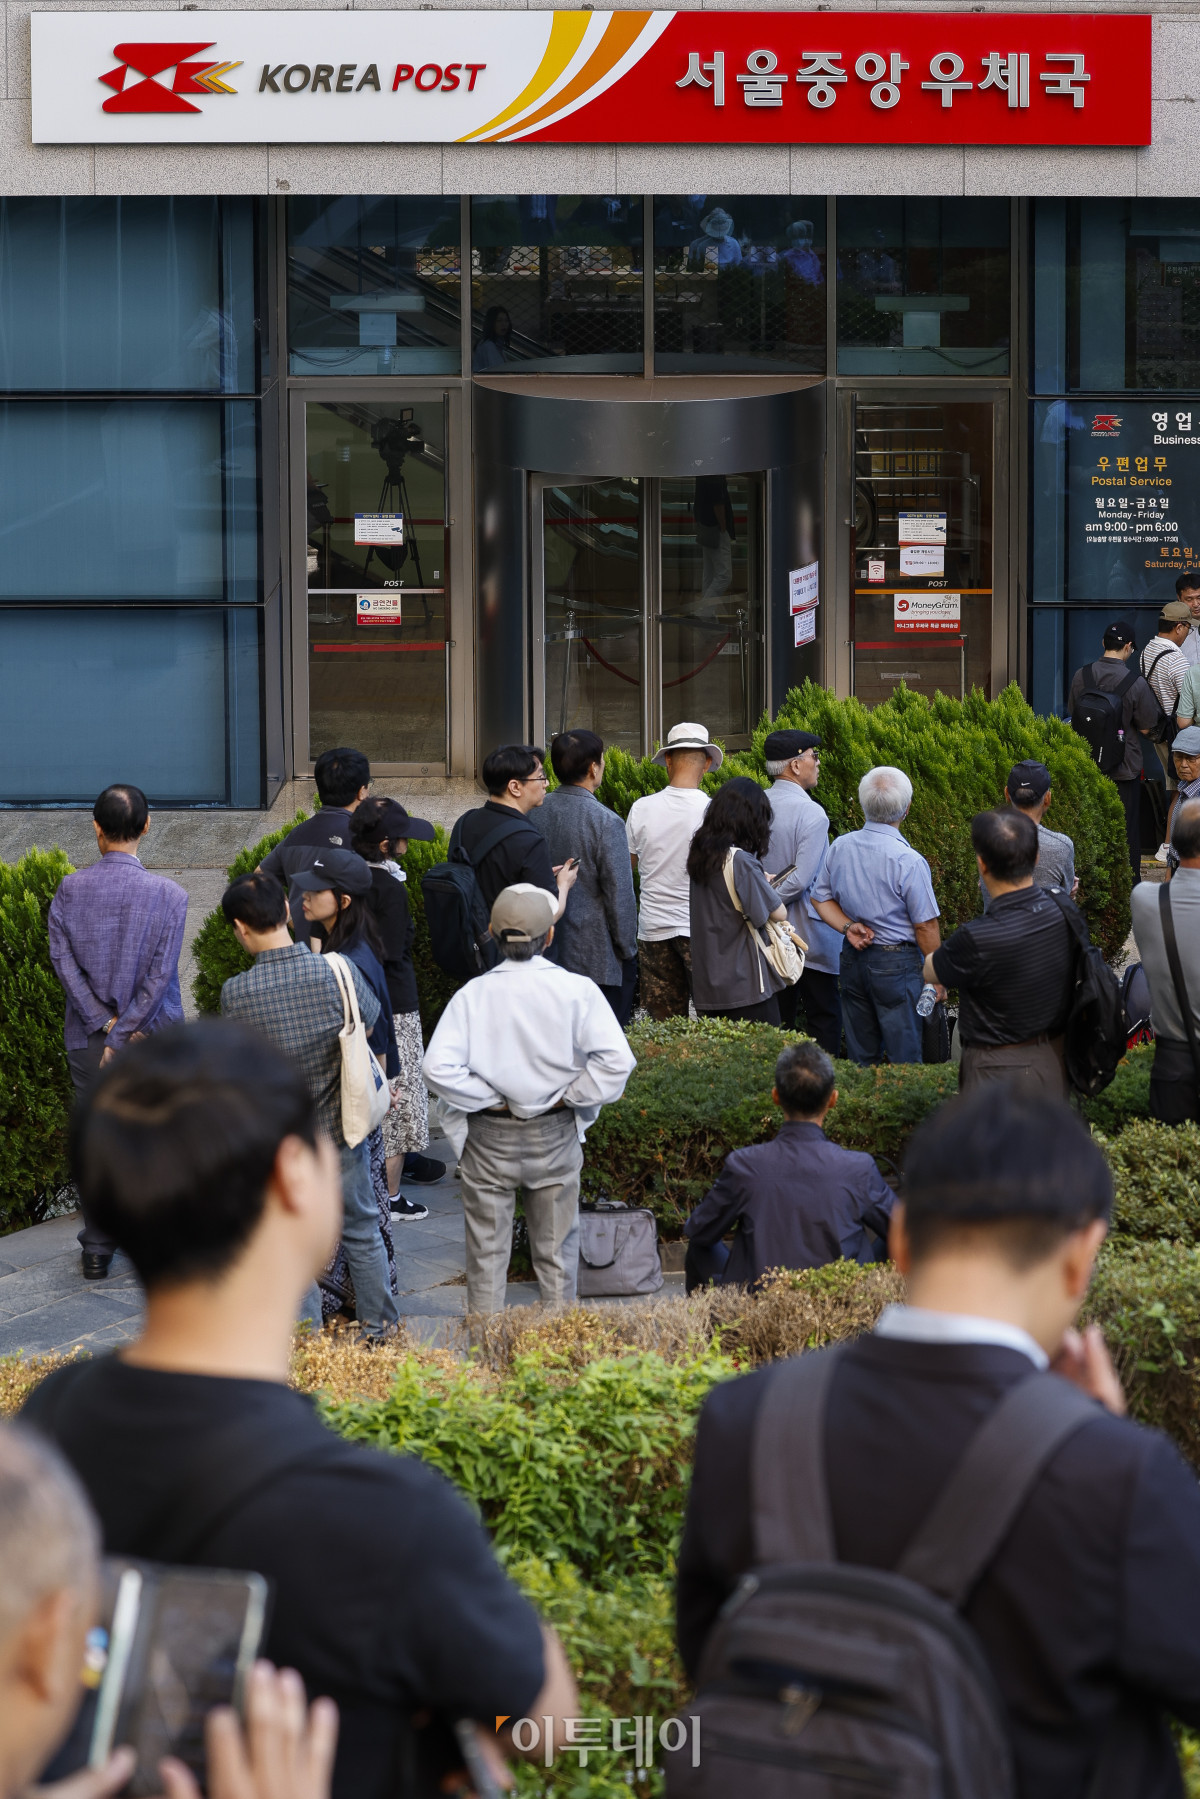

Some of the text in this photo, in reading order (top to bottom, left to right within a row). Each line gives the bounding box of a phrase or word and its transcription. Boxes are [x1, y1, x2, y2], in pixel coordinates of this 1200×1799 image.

[258, 64, 487, 92] KOREA POST
[1091, 476, 1172, 486] Postal Service
[1085, 523, 1102, 532] am
[1104, 522, 1127, 532] 9:00
[1136, 523, 1153, 533] pm
[1155, 522, 1178, 532] 6:00
